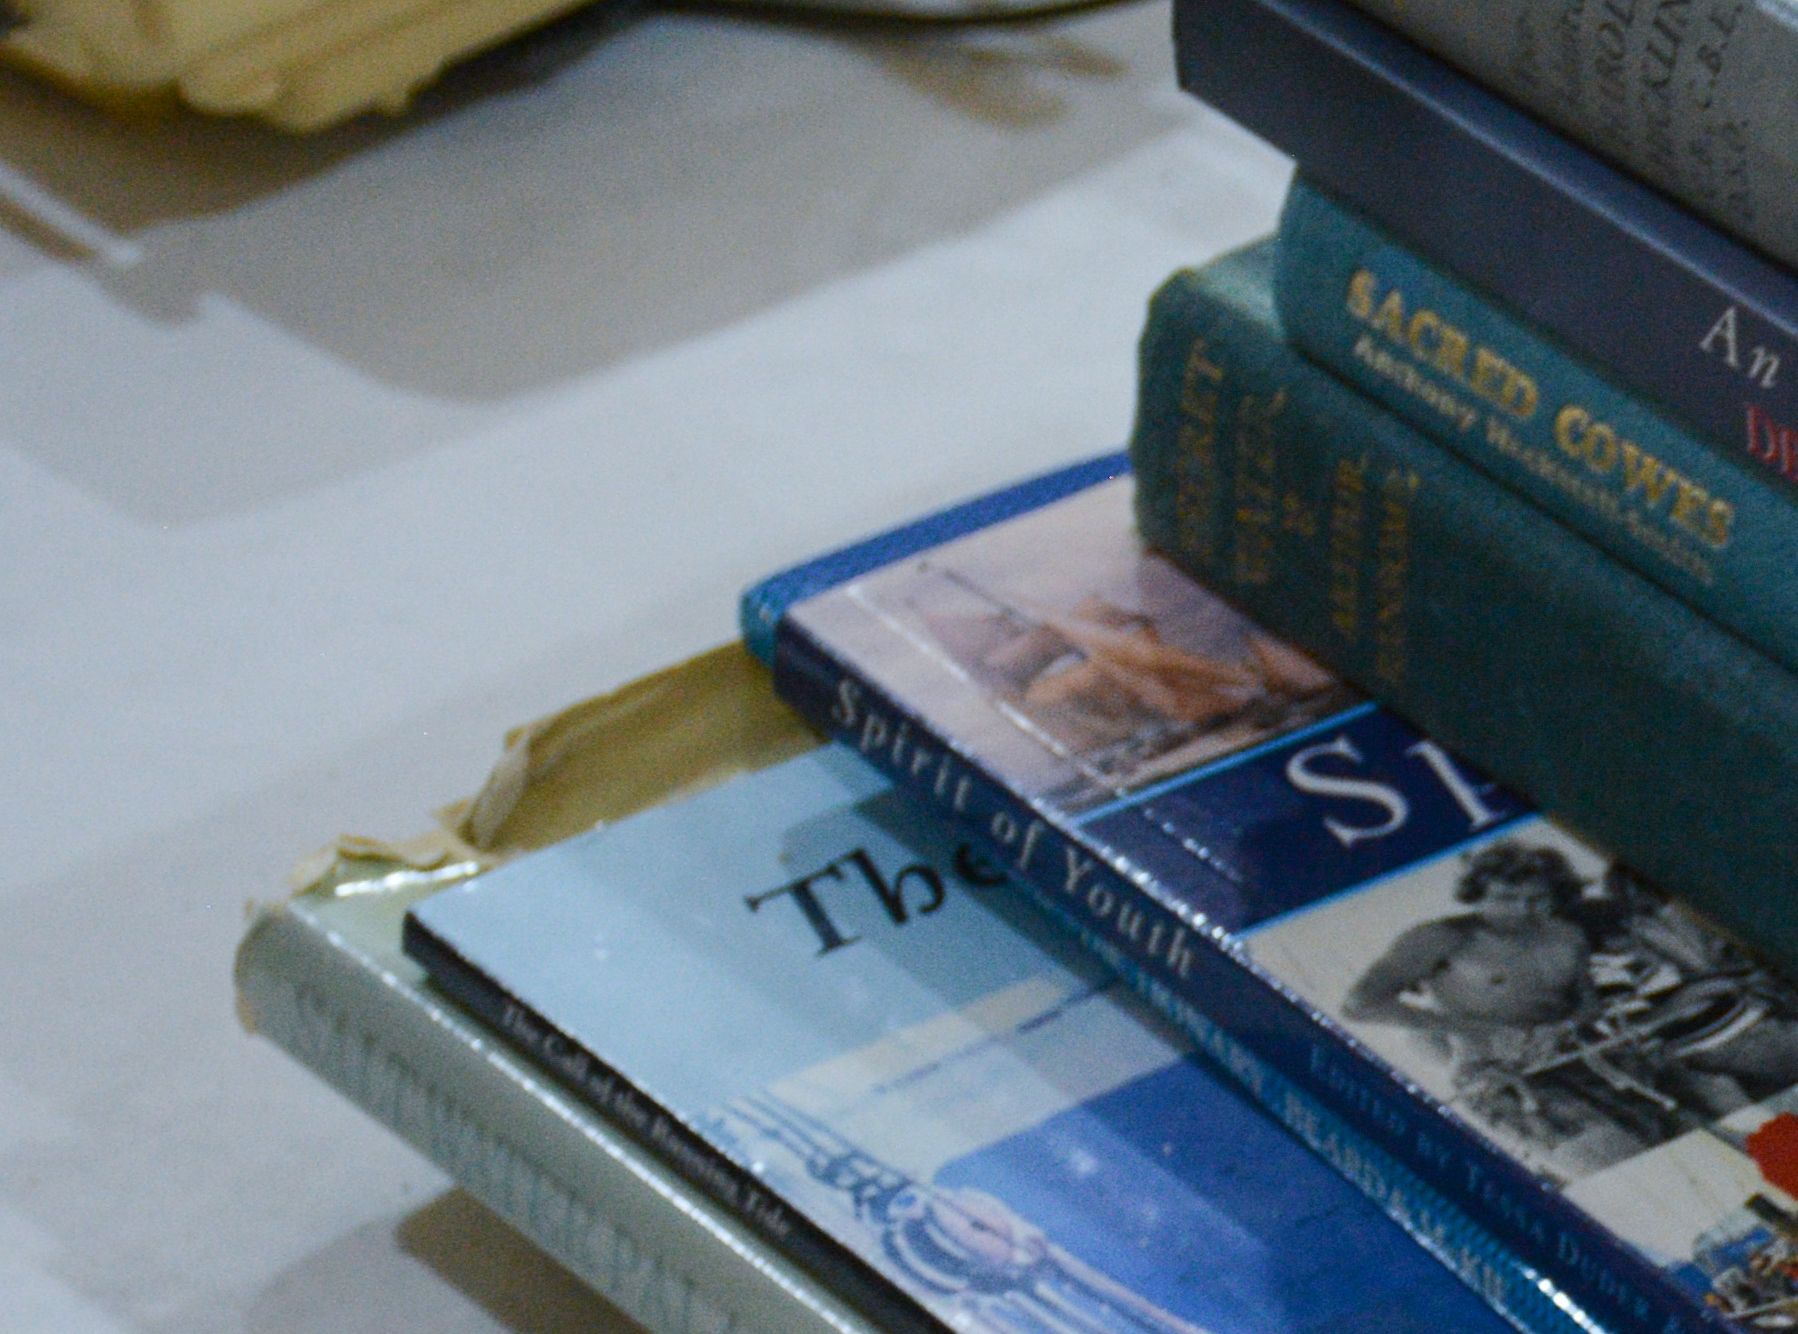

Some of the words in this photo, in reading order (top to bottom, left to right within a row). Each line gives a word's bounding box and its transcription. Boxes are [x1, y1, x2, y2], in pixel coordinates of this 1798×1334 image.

[1345, 267, 1541, 419] SACRED
[1553, 403, 1737, 551] COWES
[1699, 304, 1783, 391] An
[830, 676, 974, 814] Spirit
[991, 814, 1048, 870] of
[1061, 845, 1193, 981] Youth
